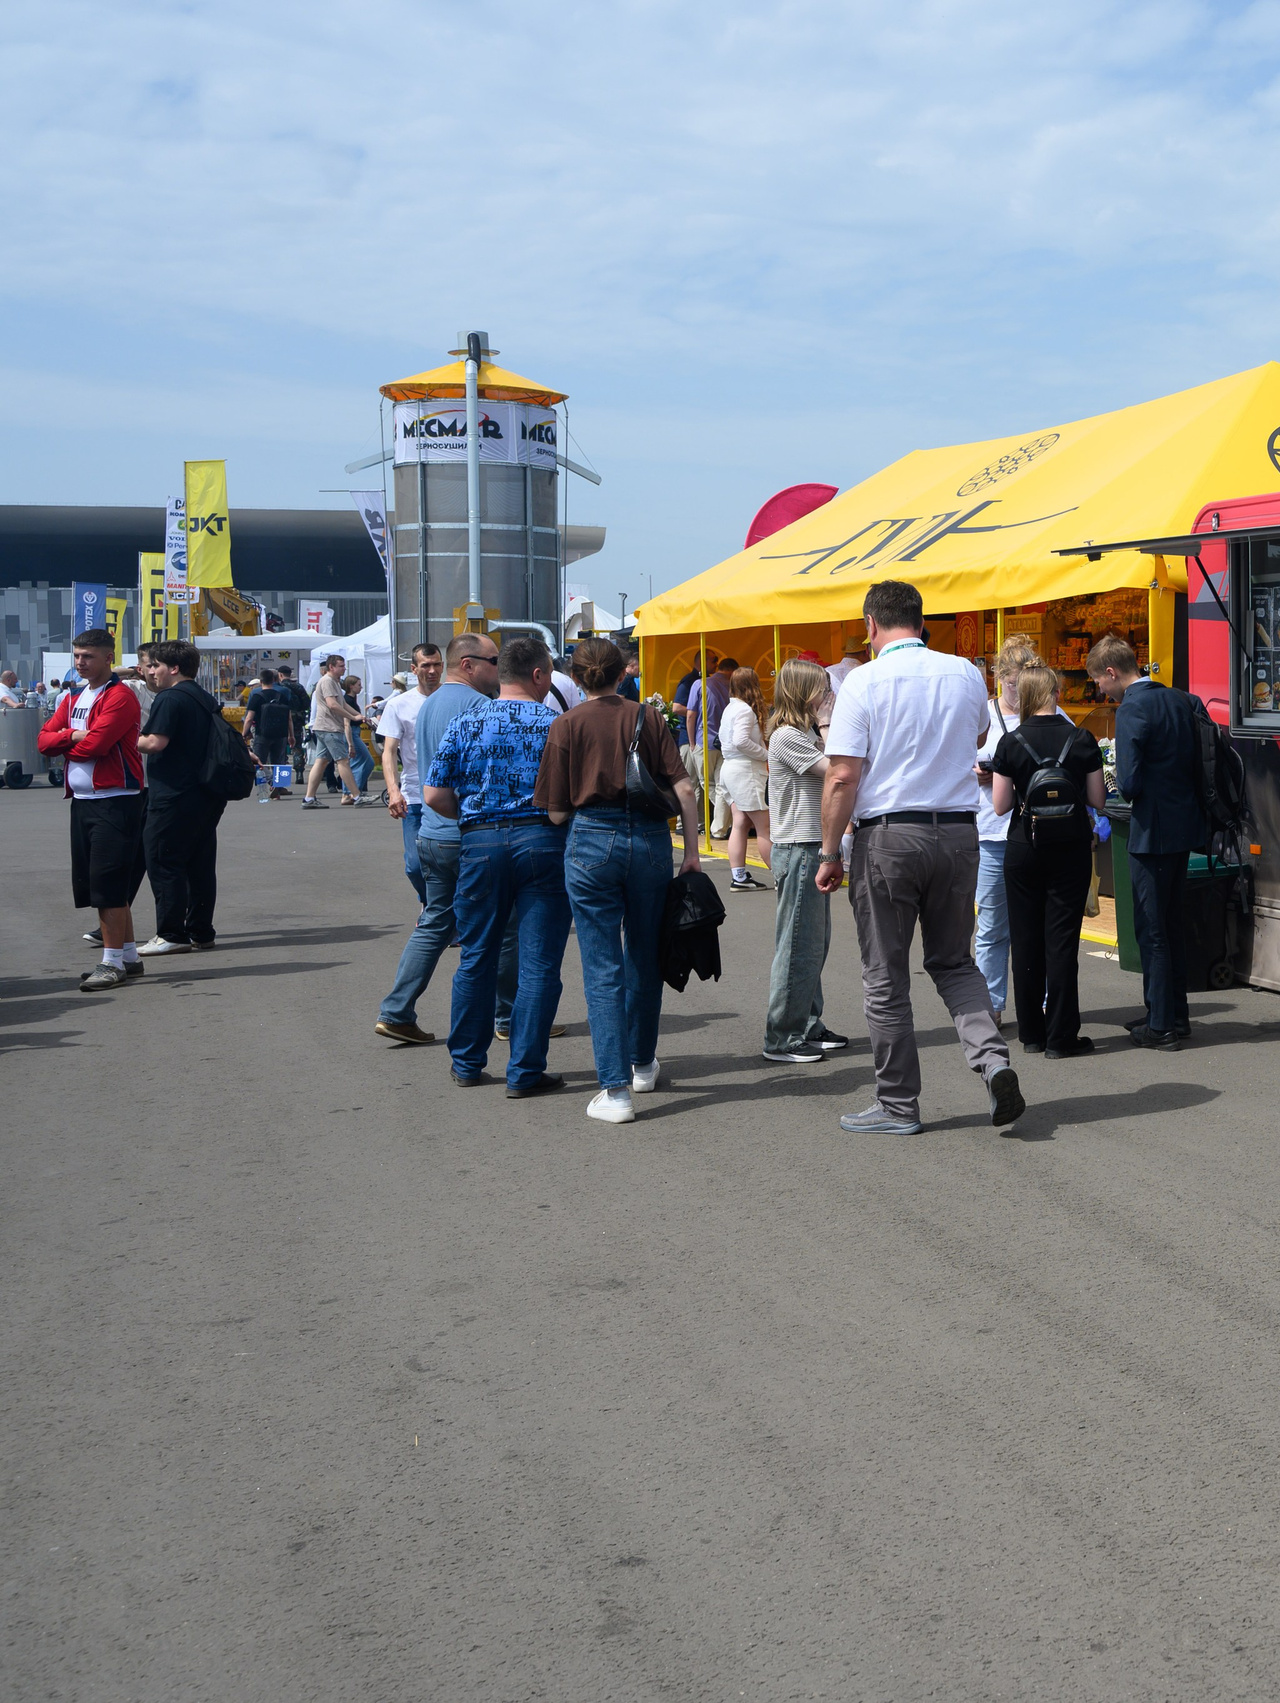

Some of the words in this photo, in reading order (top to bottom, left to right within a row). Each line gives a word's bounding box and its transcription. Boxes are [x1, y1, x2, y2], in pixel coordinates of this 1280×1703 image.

[416, 443, 482, 451] ЗЕРНОСУШИЛИ
[189, 512, 228, 537] JKT
[1008, 620, 1037, 632] ATLANT
